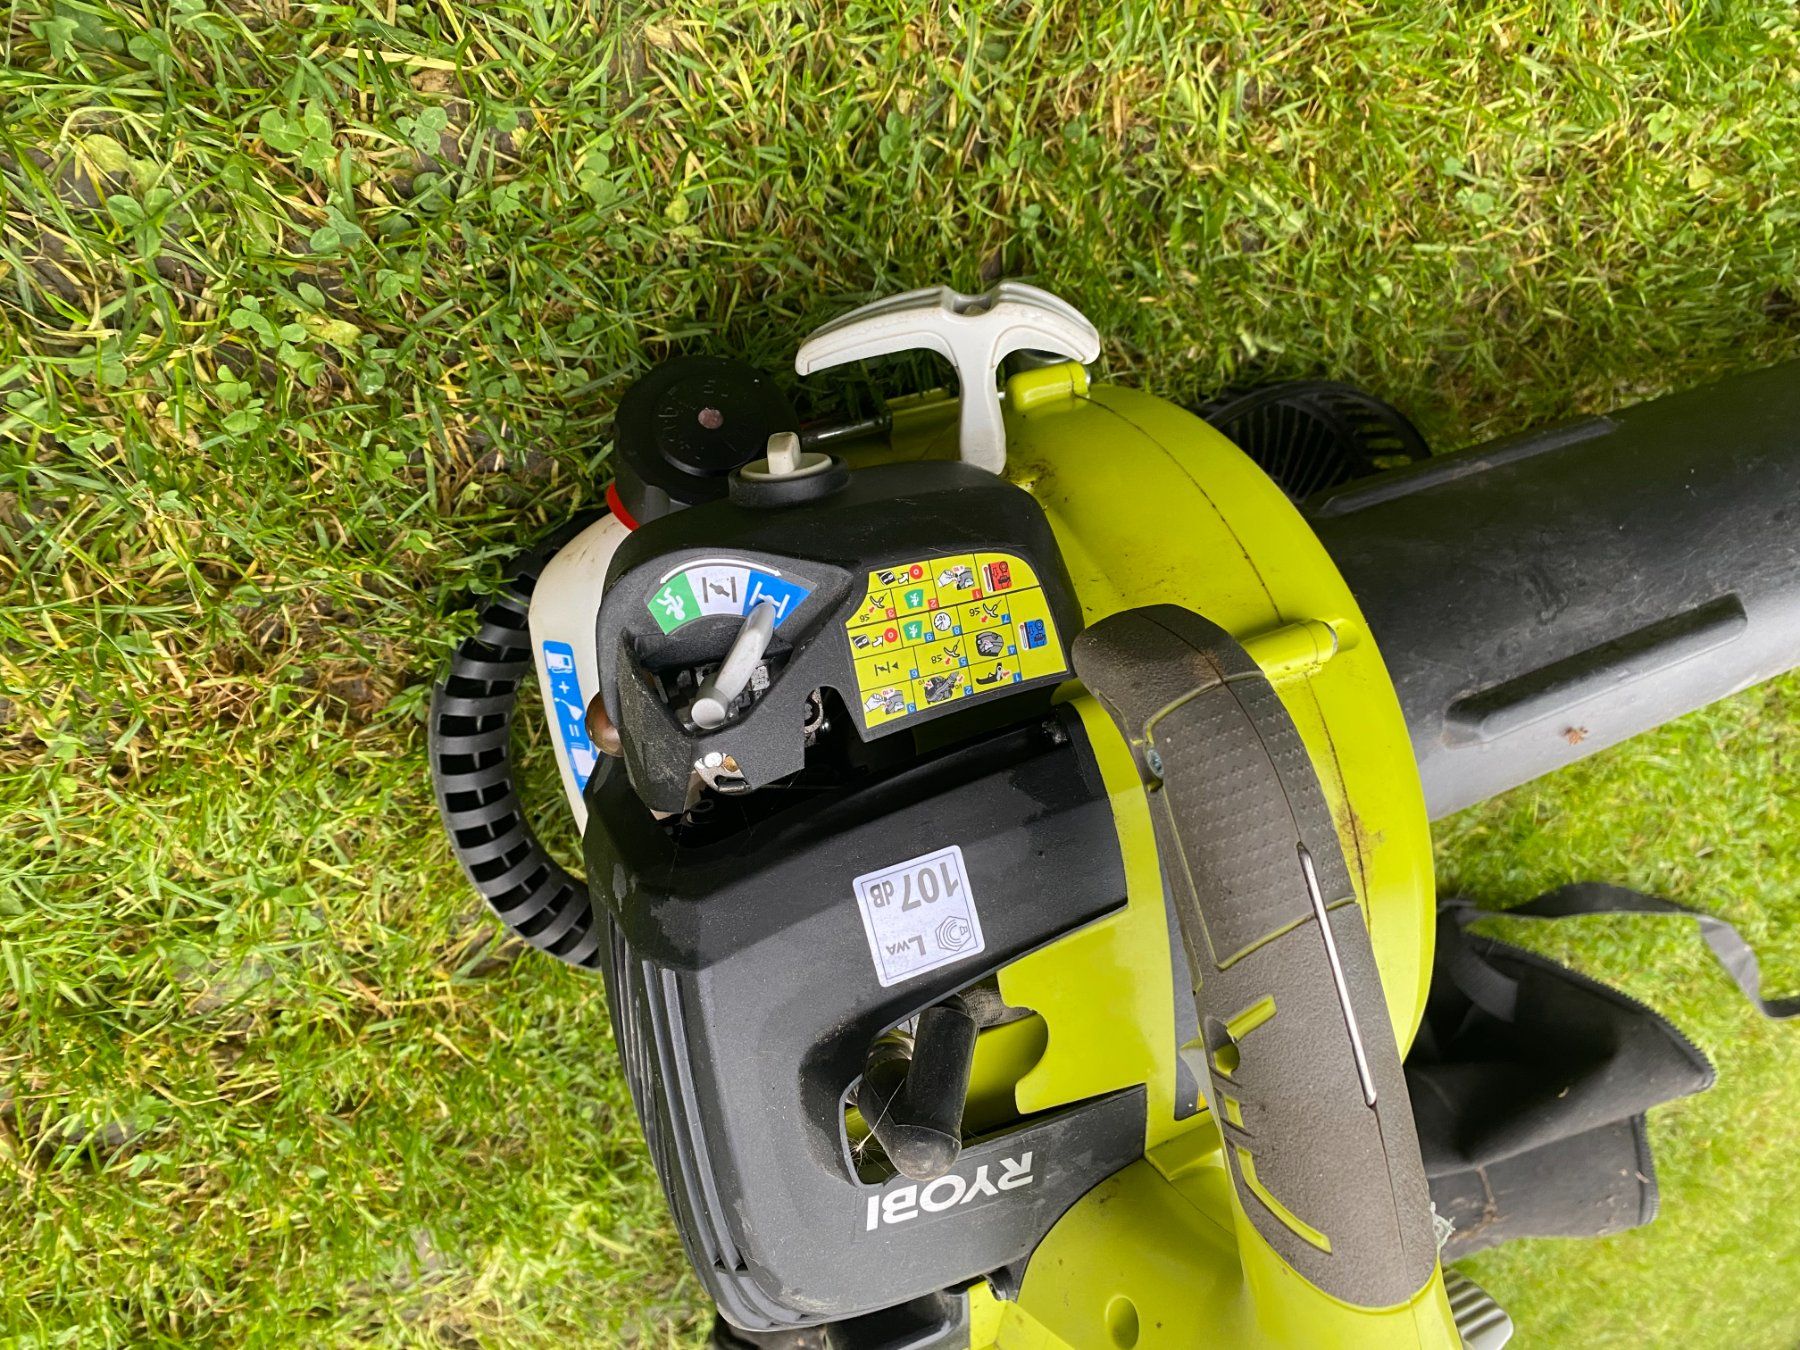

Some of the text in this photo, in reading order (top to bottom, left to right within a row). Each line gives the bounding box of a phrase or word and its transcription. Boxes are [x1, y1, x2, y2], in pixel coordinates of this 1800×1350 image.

[869, 861, 959, 912] 107 dB
[866, 1151, 1034, 1231] RYOBI
